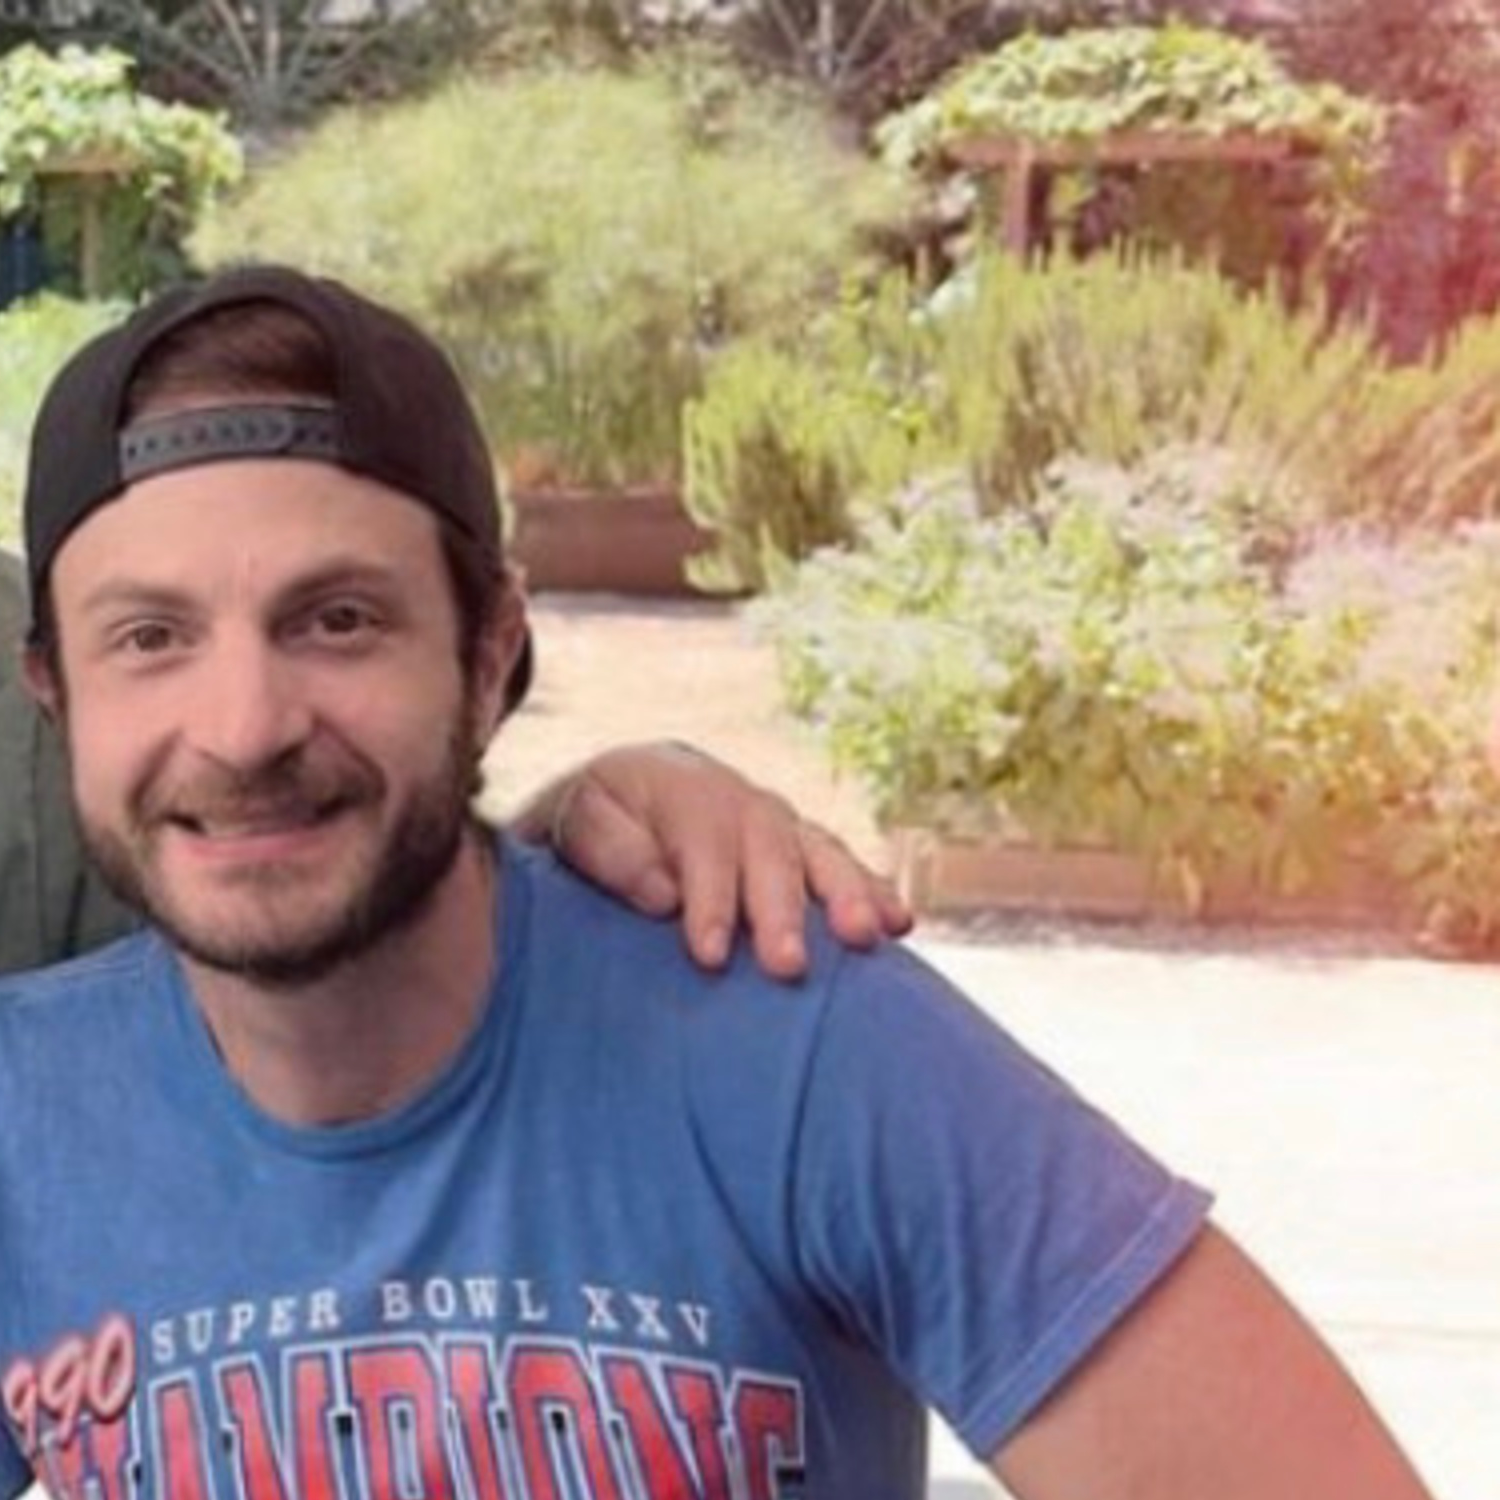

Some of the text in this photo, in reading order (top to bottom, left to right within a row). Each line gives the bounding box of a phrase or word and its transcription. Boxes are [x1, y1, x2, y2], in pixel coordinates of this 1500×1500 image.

[150, 1277, 710, 1365] SUPER BOWL XXV
